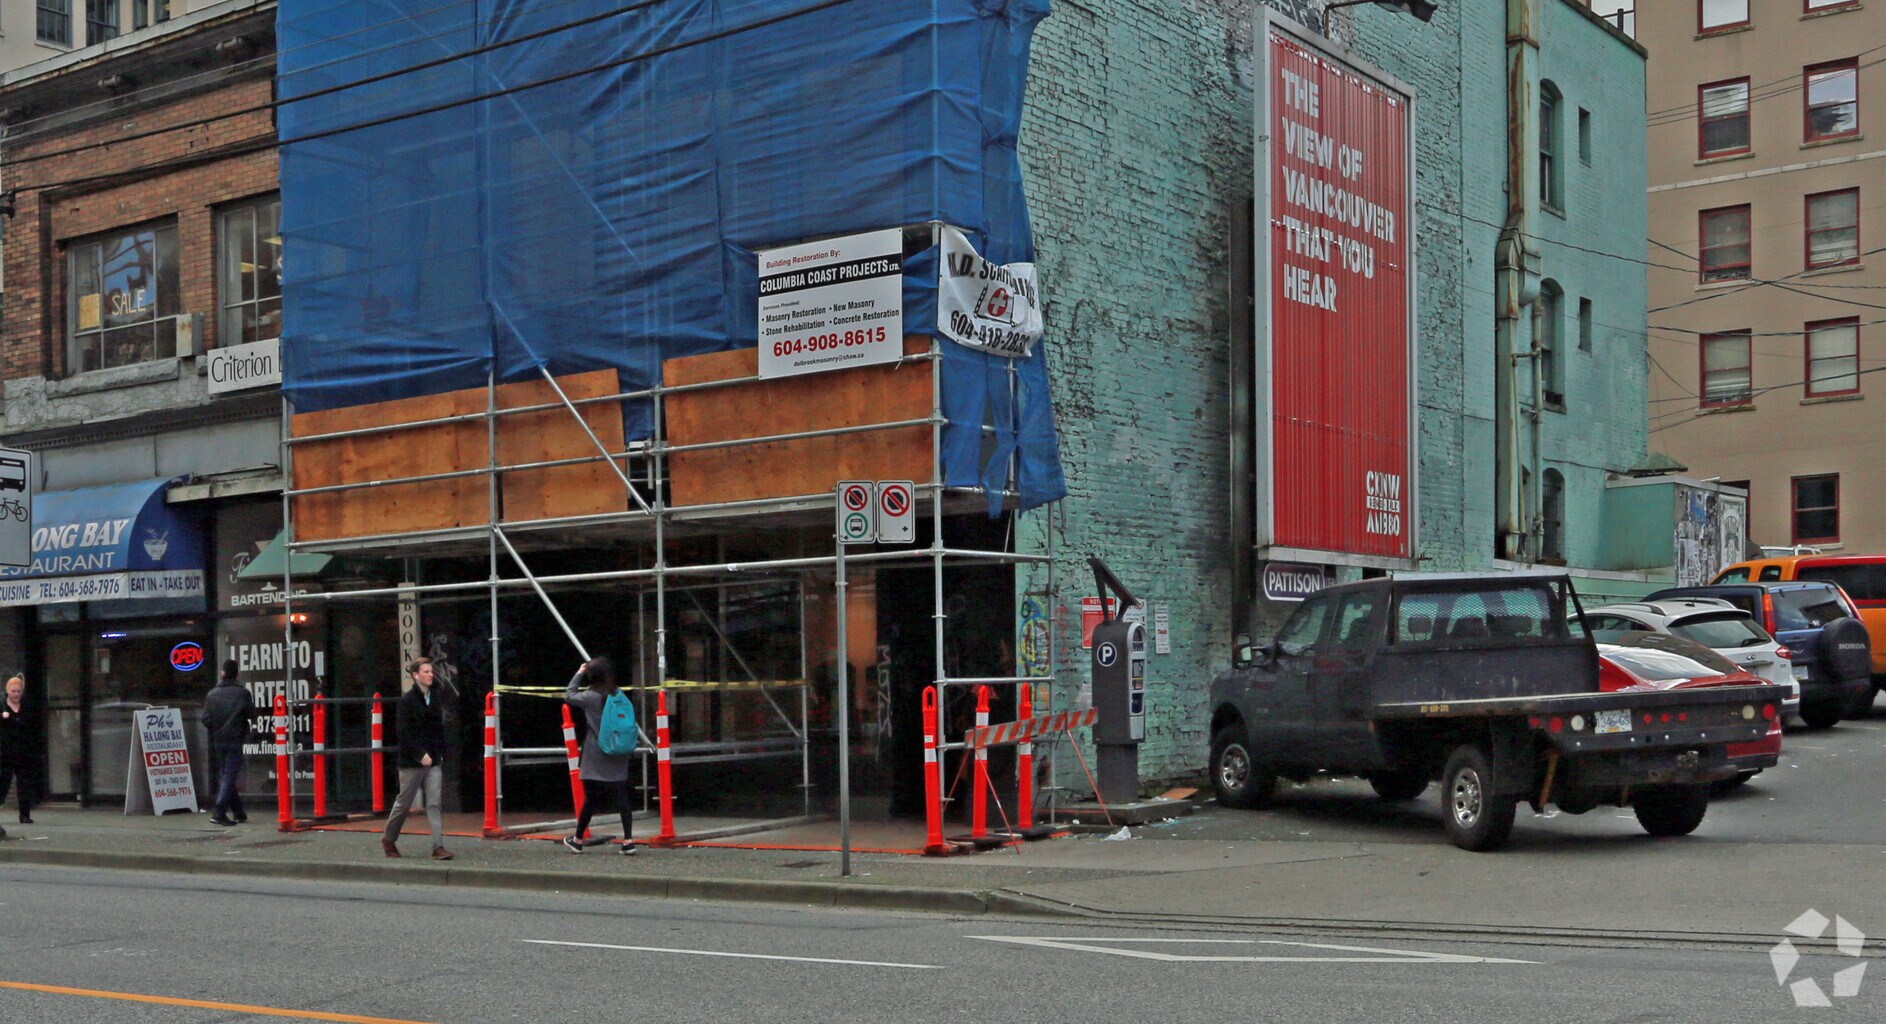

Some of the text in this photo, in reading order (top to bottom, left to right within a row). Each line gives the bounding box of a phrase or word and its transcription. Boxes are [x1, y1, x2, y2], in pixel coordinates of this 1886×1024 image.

[1282, 68, 1319, 118] THE
[1282, 116, 1363, 182] VIEW OF
[1282, 165, 1396, 244] VANCOUVER
[1283, 214, 1375, 279] THAT YOU
[766, 250, 841, 269] Building Restoration By:
[760, 259, 900, 293] COLUMBIA COAST PROJECTS LTD.
[1283, 263, 1337, 312] HEAR
[111, 286, 147, 316] SALE
[833, 299, 875, 312] New Masonry
[766, 306, 826, 323] Masonry Restoration
[833, 308, 900, 326] Concrete Restoration
[766, 320, 825, 336] Stone Rehabilitation
[773, 326, 886, 357] 604-908-8615
[211, 352, 272, 383] Criterion
[1366, 470, 1400, 500] CKNW
[32, 519, 129, 553] ONG BAY
[39, 583, 56, 598] TEL:
[59, 578, 119, 597] 604-568-7976
[131, 576, 201, 592] EAT IN TAKE OUT
[1269, 571, 1320, 593] PATTISON
[172, 647, 203, 665] OPEN
[1102, 646, 1113, 663] P
[143, 729, 182, 742] HA LONG BAY
[146, 741, 184, 751] RESTAURANT
[150, 751, 185, 766] OPEN
